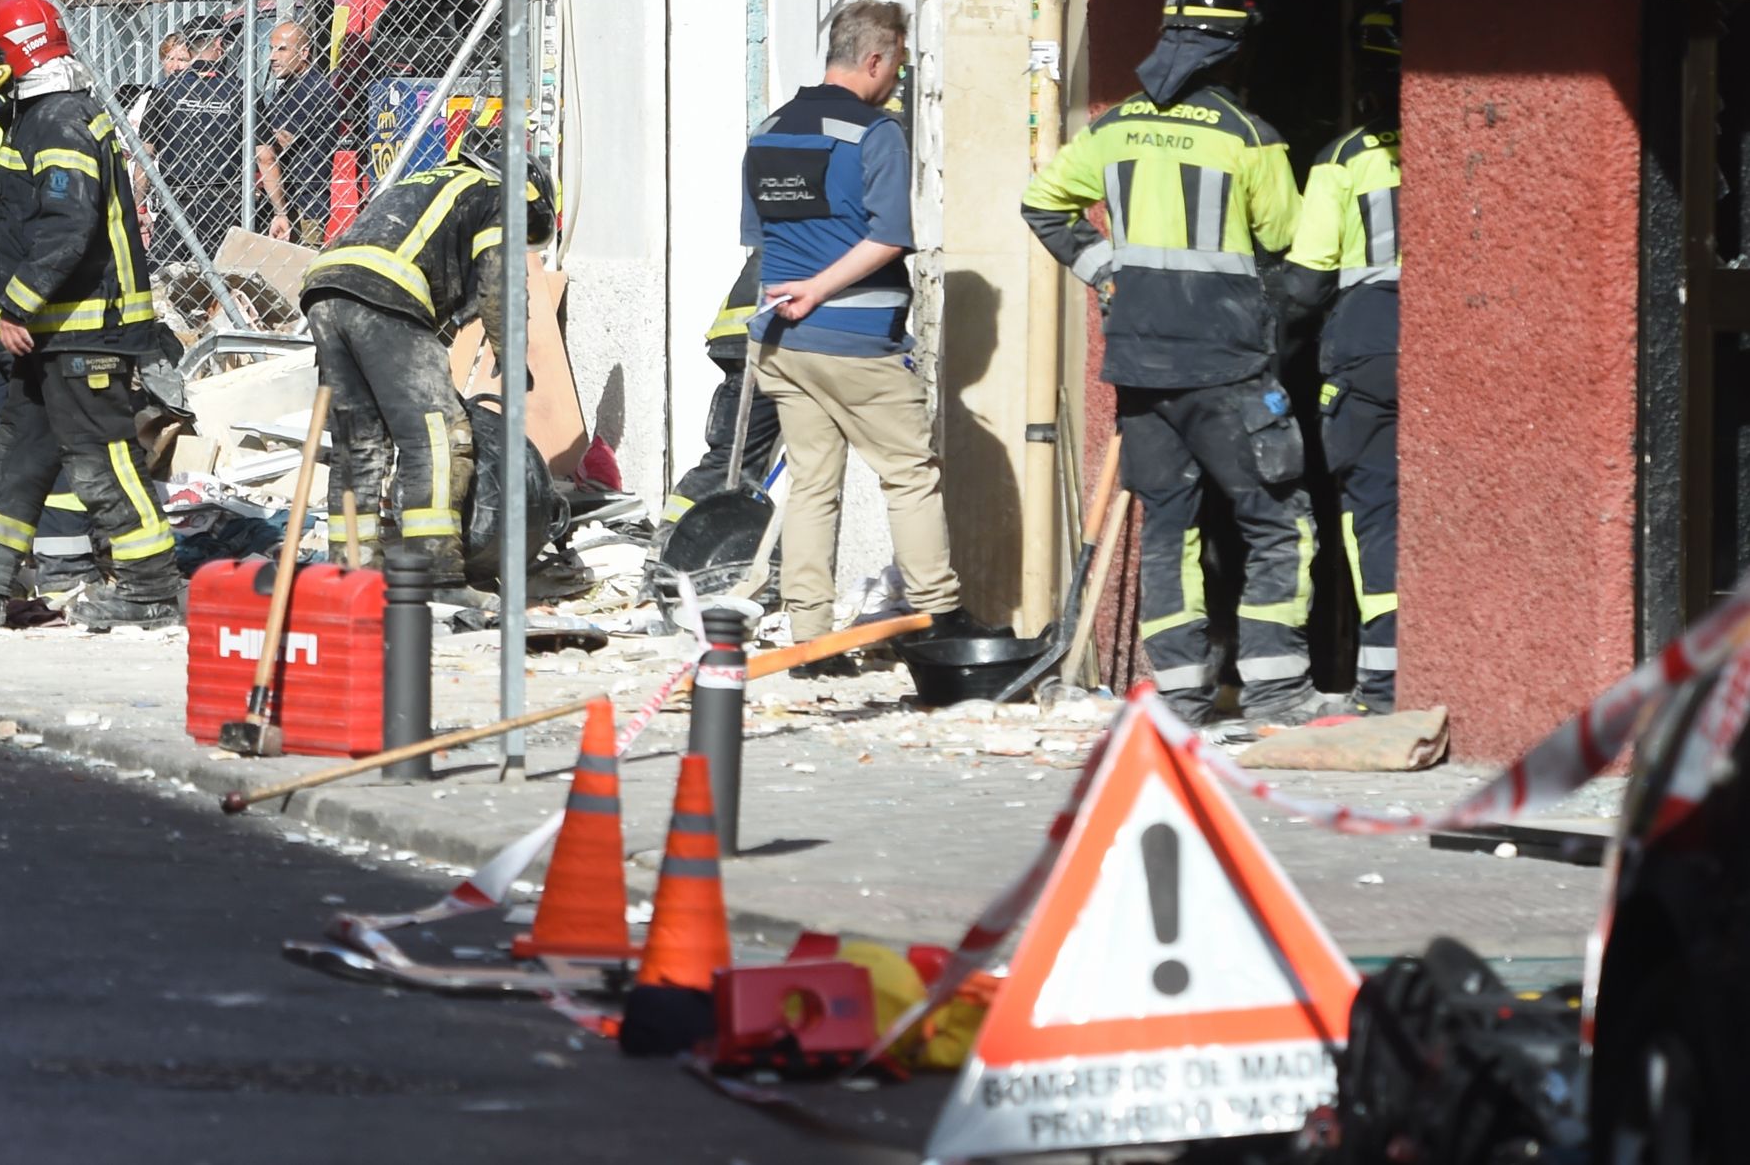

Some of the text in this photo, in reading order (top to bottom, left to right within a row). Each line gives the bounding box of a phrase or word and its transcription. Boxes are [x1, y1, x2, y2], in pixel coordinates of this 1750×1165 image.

[1119, 101, 1222, 124] BOMEROS
[1125, 132, 1195, 150] MADRID
[983, 1063, 1168, 1108] BOMBEROS
[1182, 1057, 1226, 1089] DE
